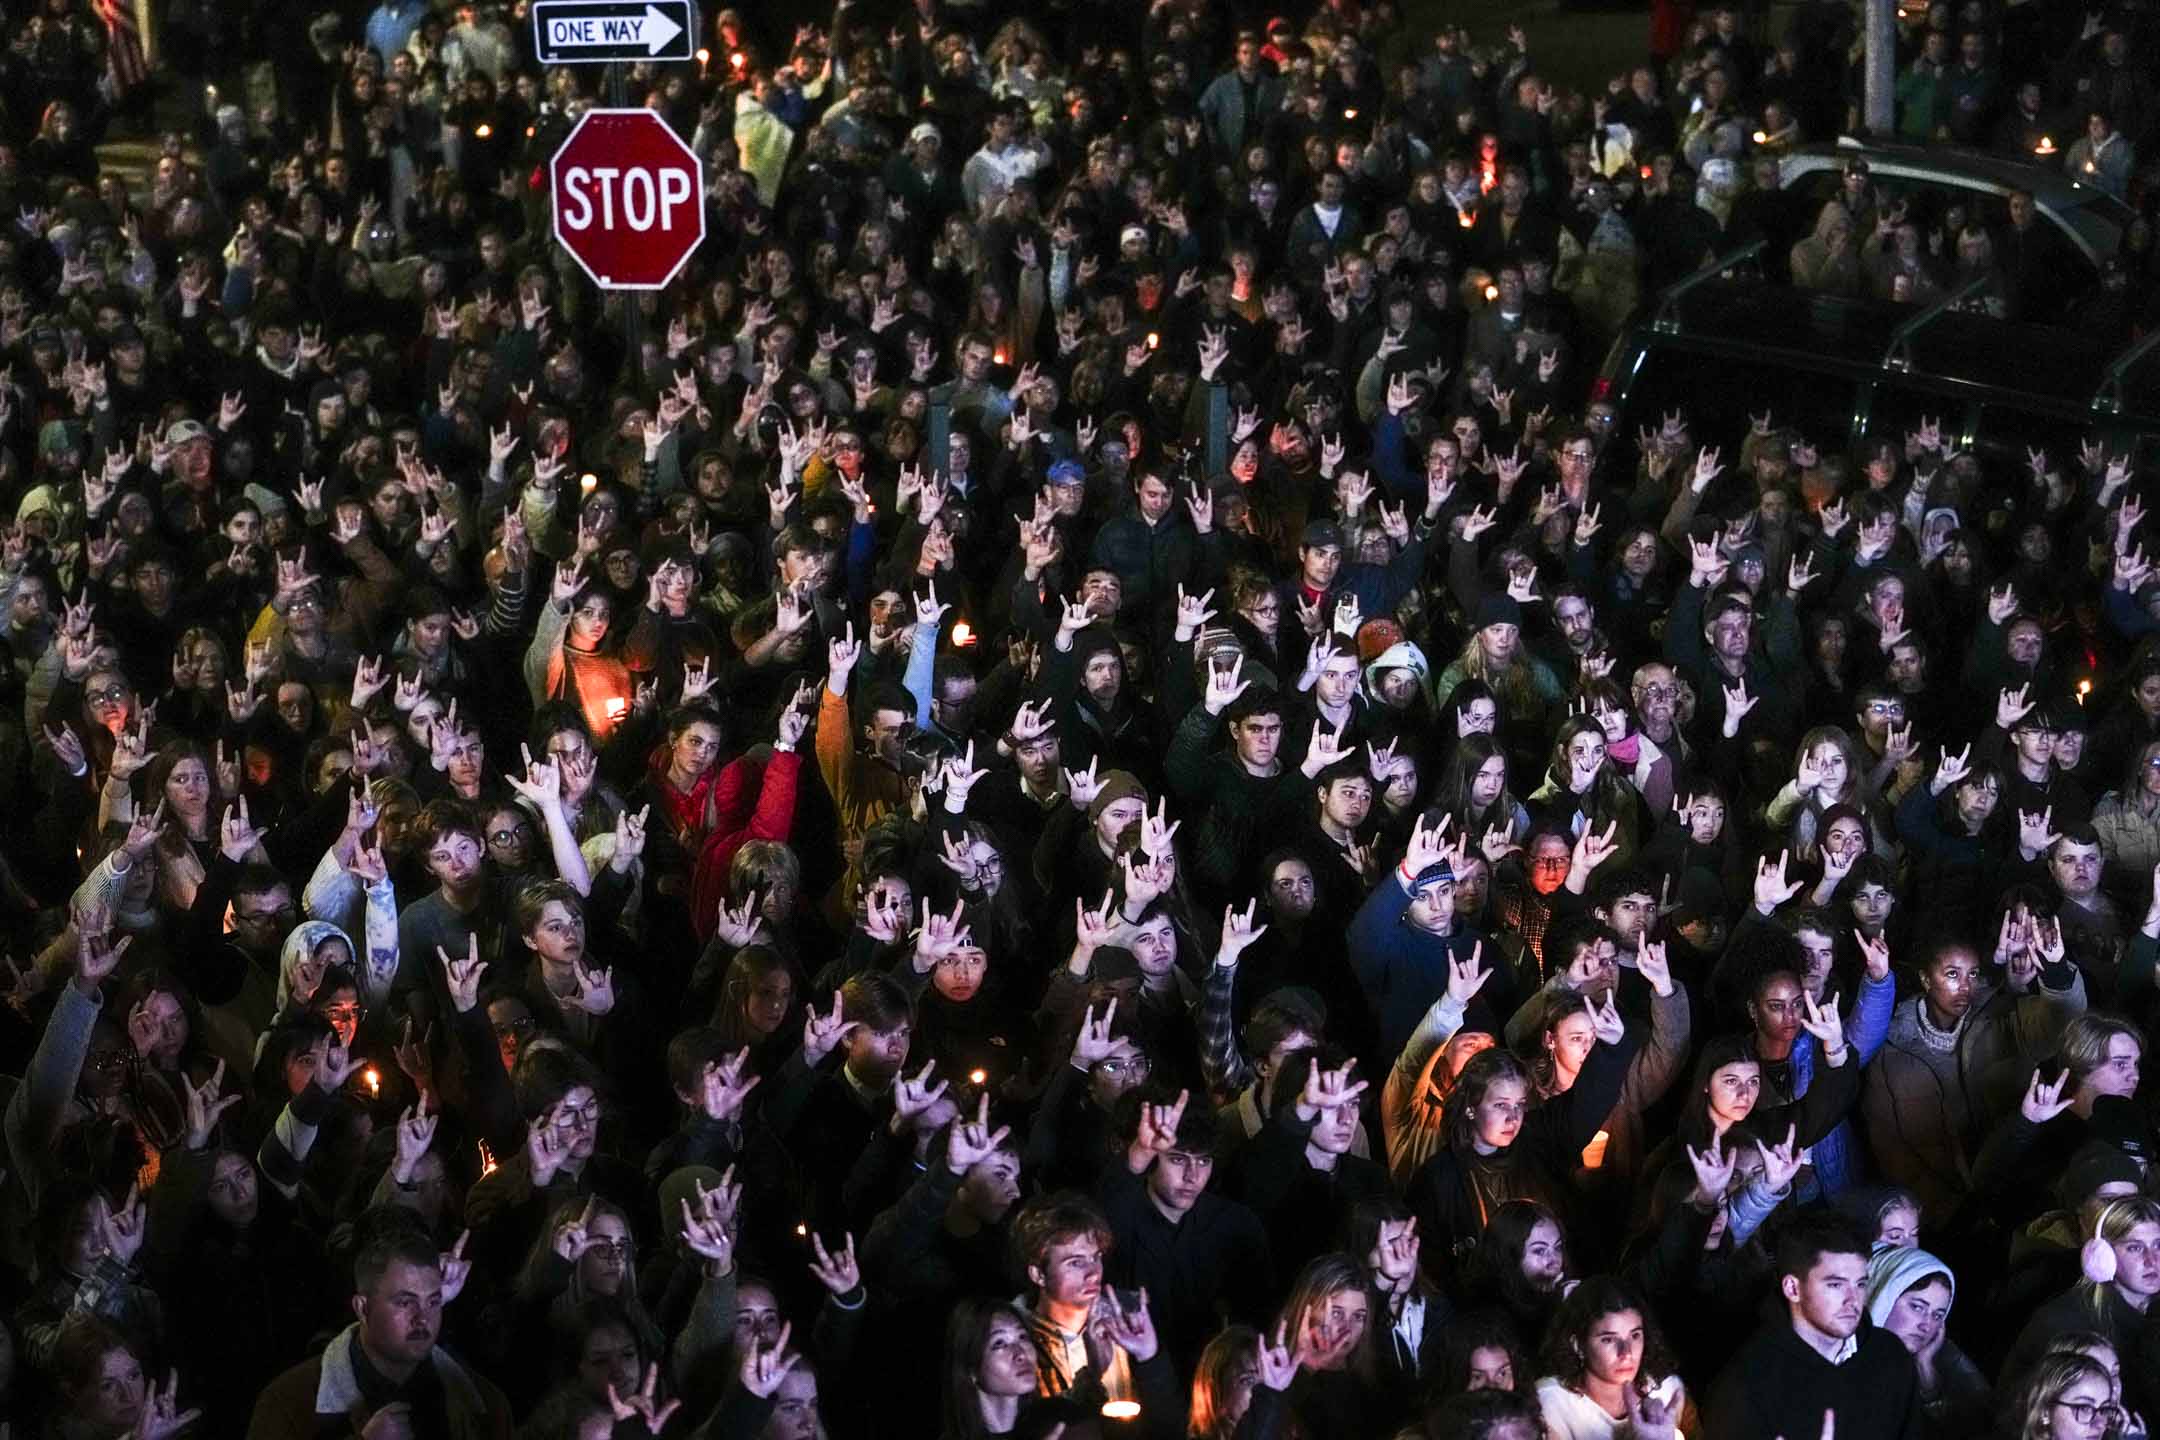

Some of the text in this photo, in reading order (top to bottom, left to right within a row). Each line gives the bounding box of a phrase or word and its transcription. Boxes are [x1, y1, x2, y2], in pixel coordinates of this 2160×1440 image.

[554, 19, 643, 42] ONE WAY
[563, 166, 691, 232] STOP
